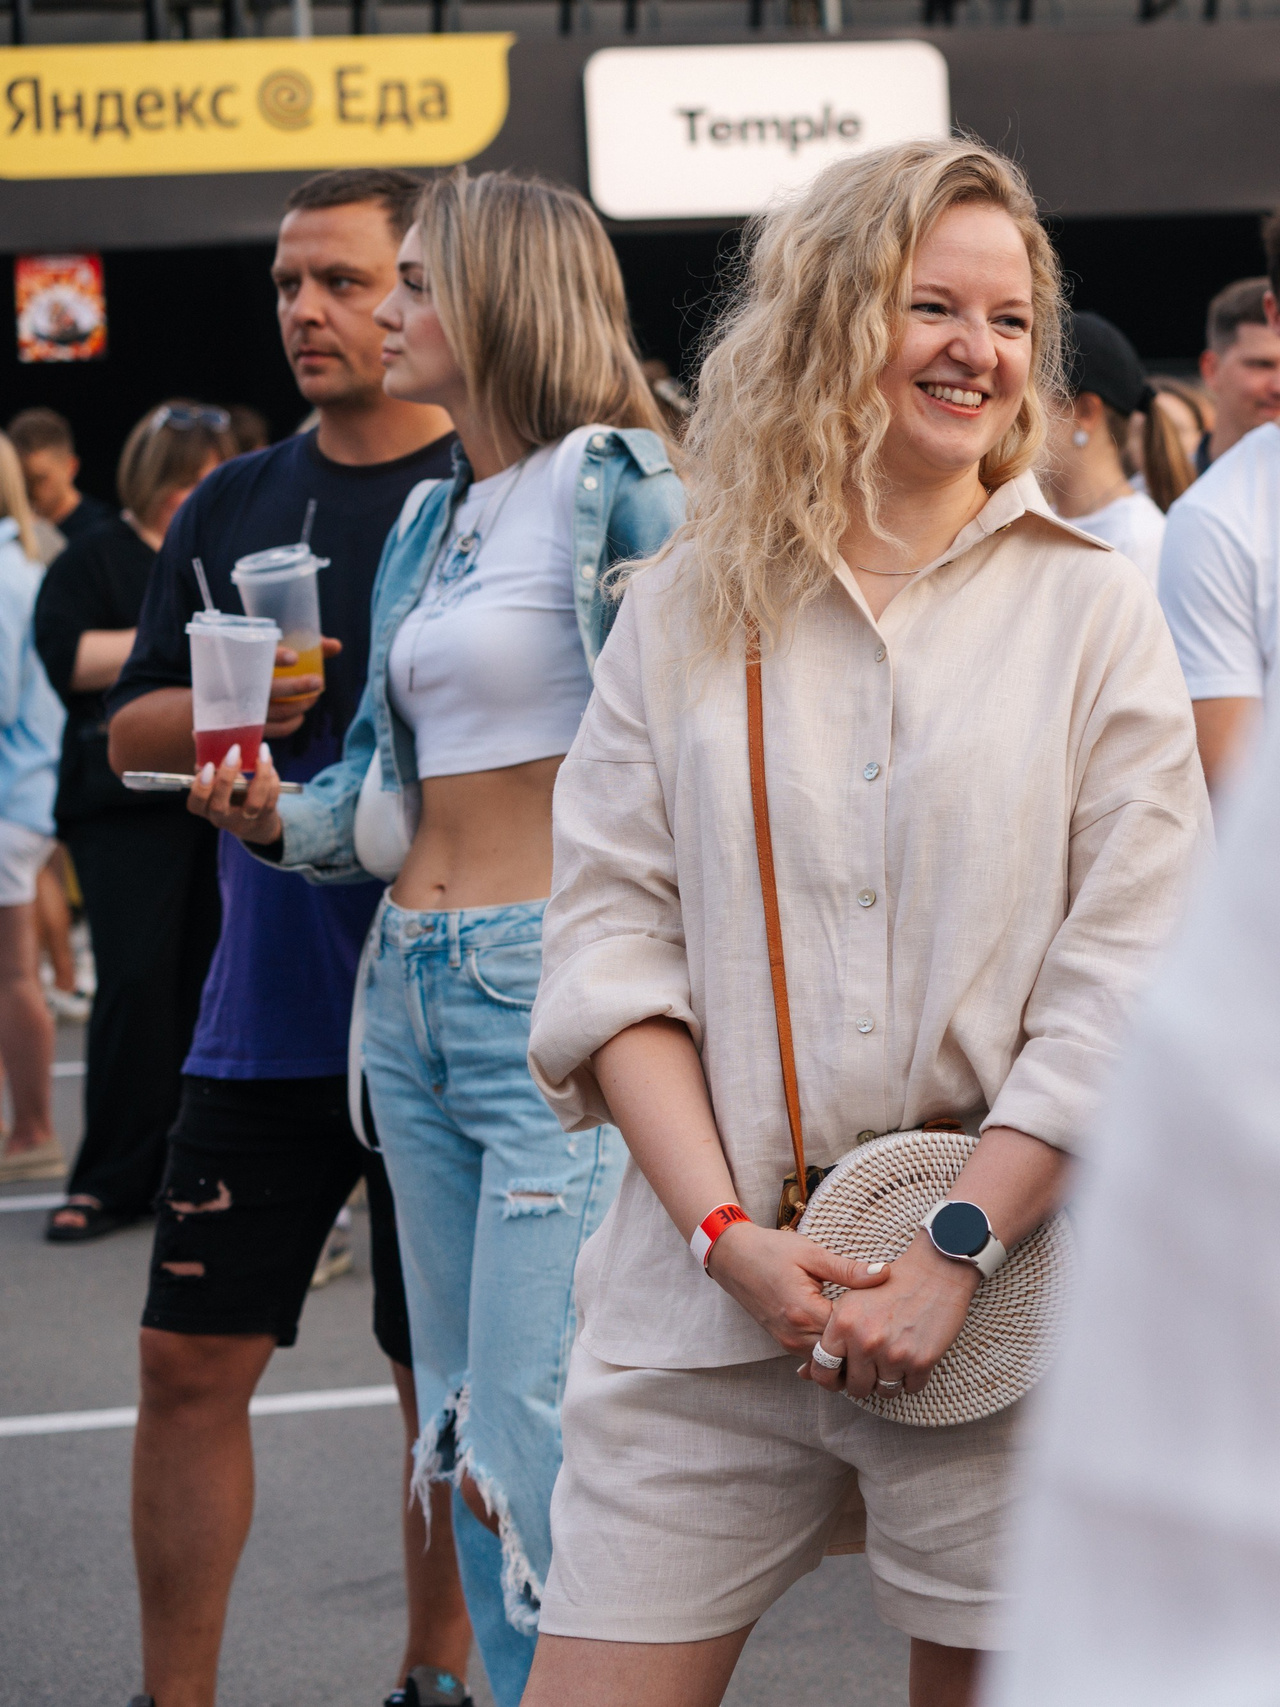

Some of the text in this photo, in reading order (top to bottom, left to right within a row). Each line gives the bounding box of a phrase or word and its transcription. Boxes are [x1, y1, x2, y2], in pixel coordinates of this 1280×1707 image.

[5, 66, 449, 138] Яндекс Еда
[678, 103, 862, 153] Temple
